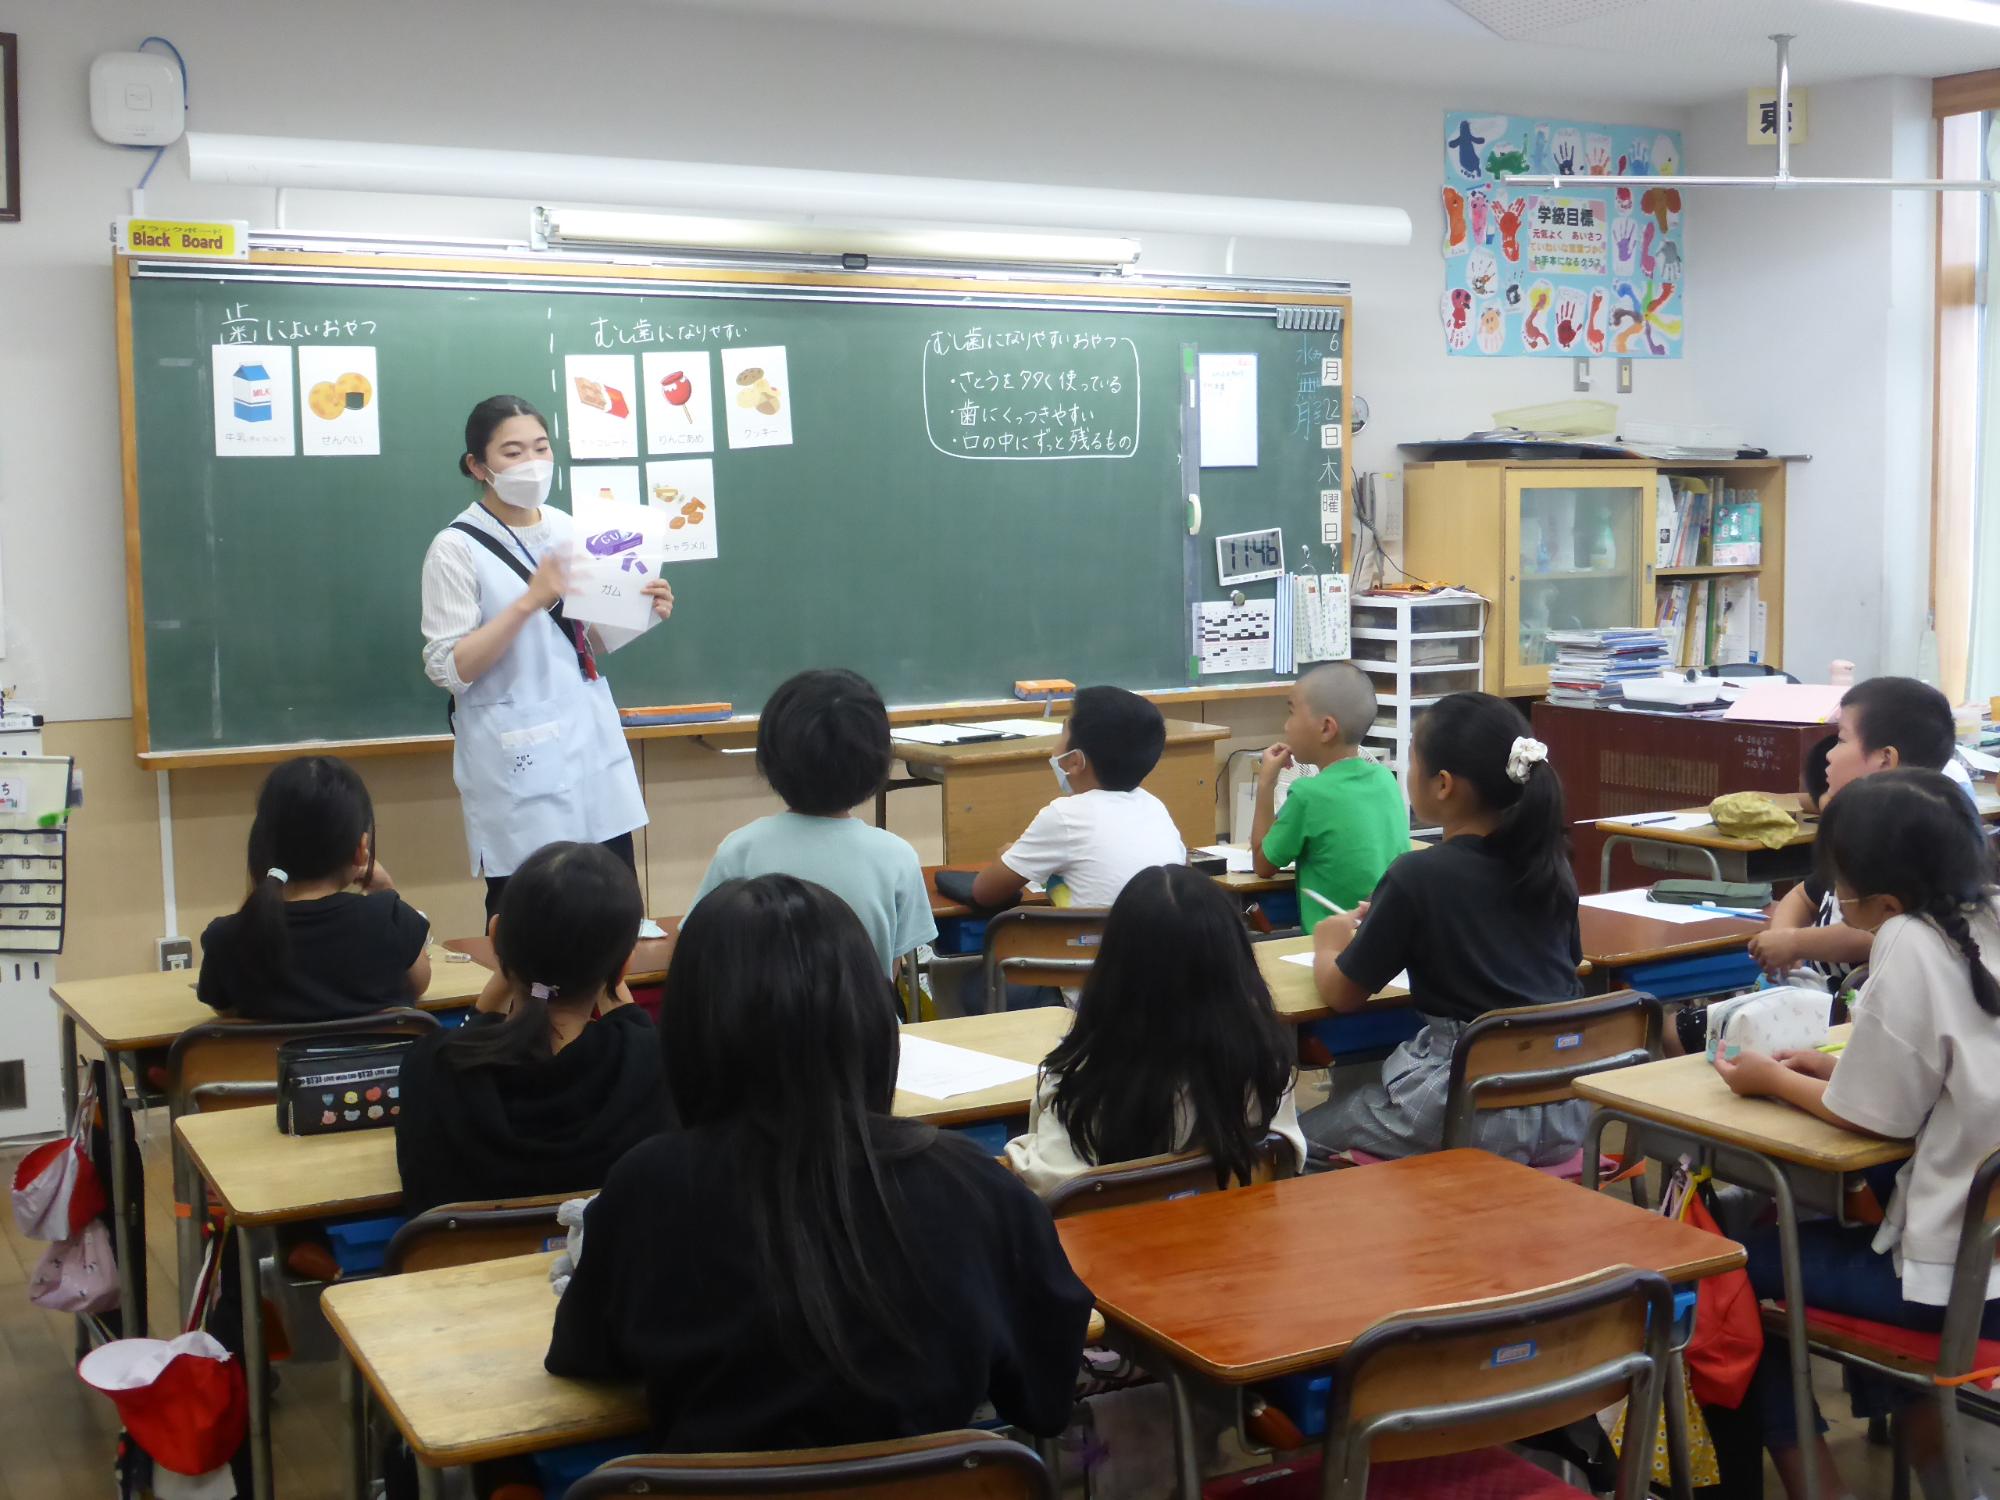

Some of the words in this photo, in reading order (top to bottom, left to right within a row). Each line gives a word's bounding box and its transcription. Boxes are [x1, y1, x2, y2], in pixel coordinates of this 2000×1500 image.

[1537, 205, 1594, 227] 学級目標
[133, 231, 171, 248] Black
[182, 234, 223, 250] Board
[1532, 229, 1562, 240] 元気よく
[1572, 231, 1602, 242] あいさつ
[1534, 255, 1601, 268] お手本になるクラス
[219, 302, 377, 345] 歯によいおやつ
[590, 317, 749, 348] むし歯になりやすい
[930, 326, 1118, 356] むし歯になりやすいおやつ
[252, 387, 272, 397] MILK
[958, 398, 1095, 426] 歯にくっつきやすい
[658, 433, 705, 445] りんごあめ
[744, 427, 779, 438] クッキー
[321, 435, 364, 445] せんべい
[962, 426, 1132, 454] 口の中にずっと残るもの
[664, 541, 707, 551] キャラメル
[1231, 537, 1279, 571] 11:46
[601, 584, 621, 597] ガム
[20, 885, 30, 895] 20
[46, 885, 56, 896] 21
[18, 910, 29, 920] 27
[46, 910, 56, 921] 28
